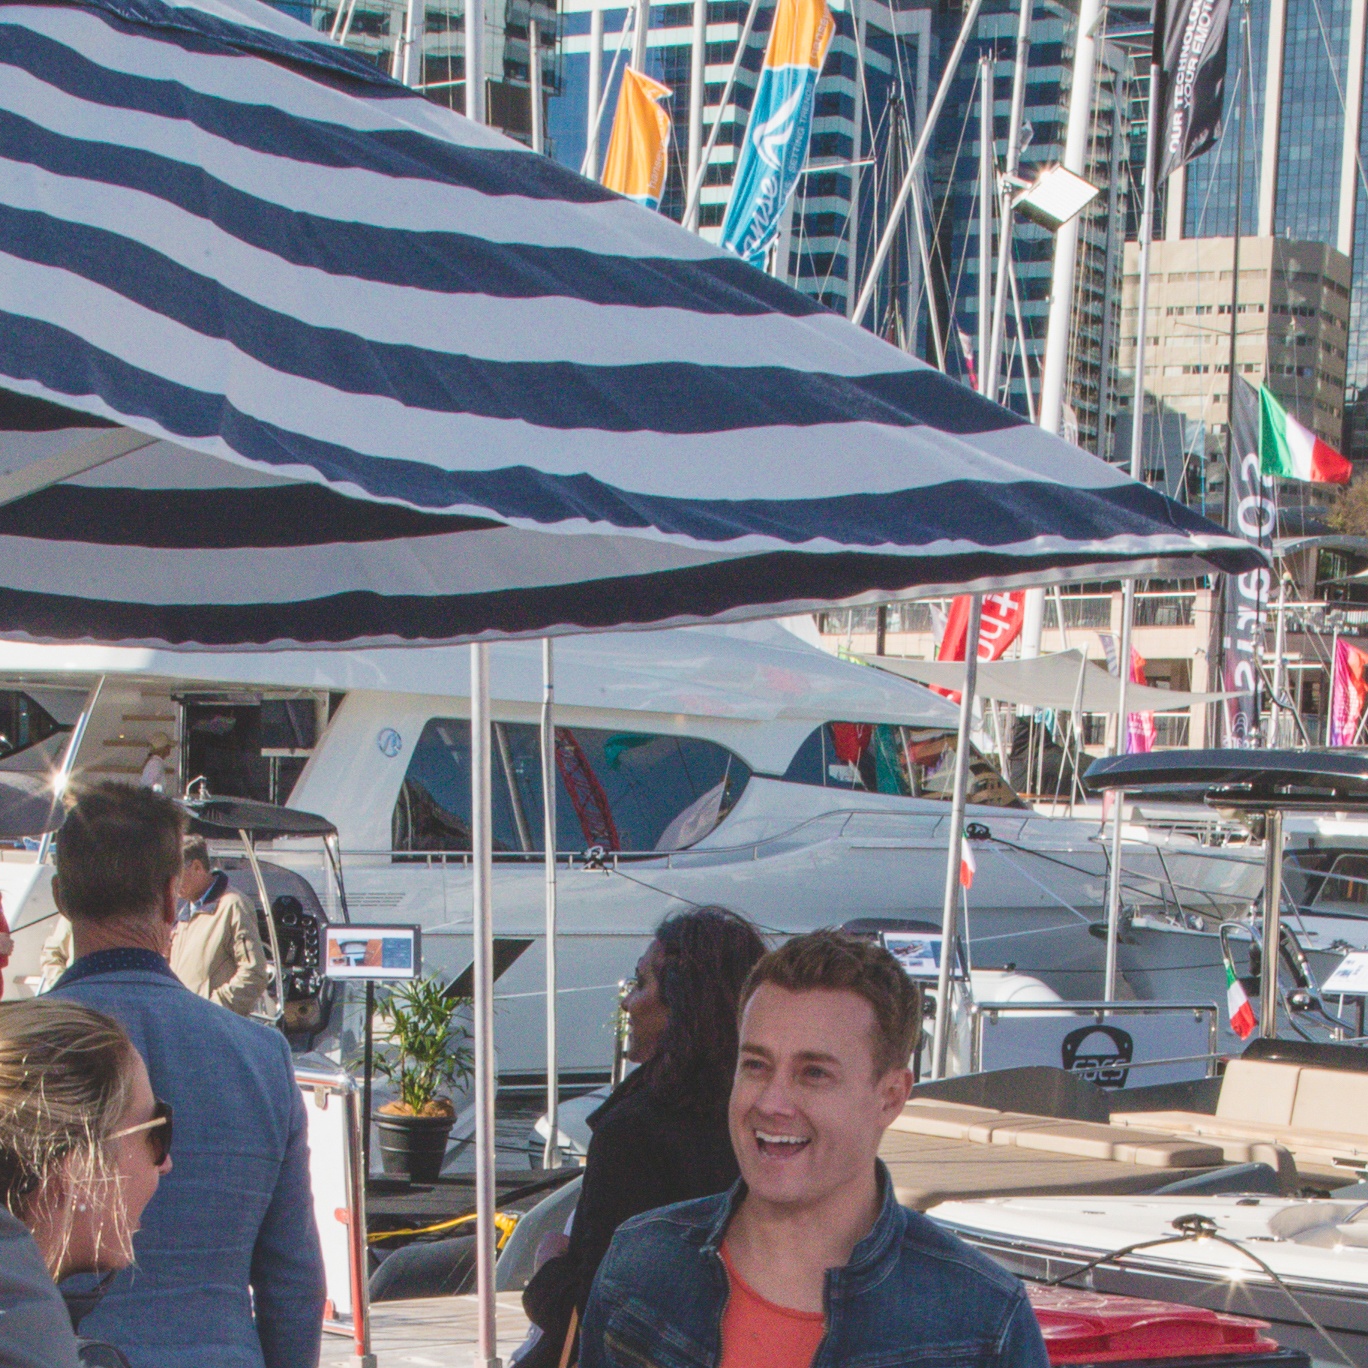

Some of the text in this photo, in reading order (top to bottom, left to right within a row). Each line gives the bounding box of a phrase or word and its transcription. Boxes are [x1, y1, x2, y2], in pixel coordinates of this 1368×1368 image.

[1183, 0, 1213, 109] YOUR EMOT
[1168, 112, 1183, 154] OUR
[726, 176, 779, 259] anse
